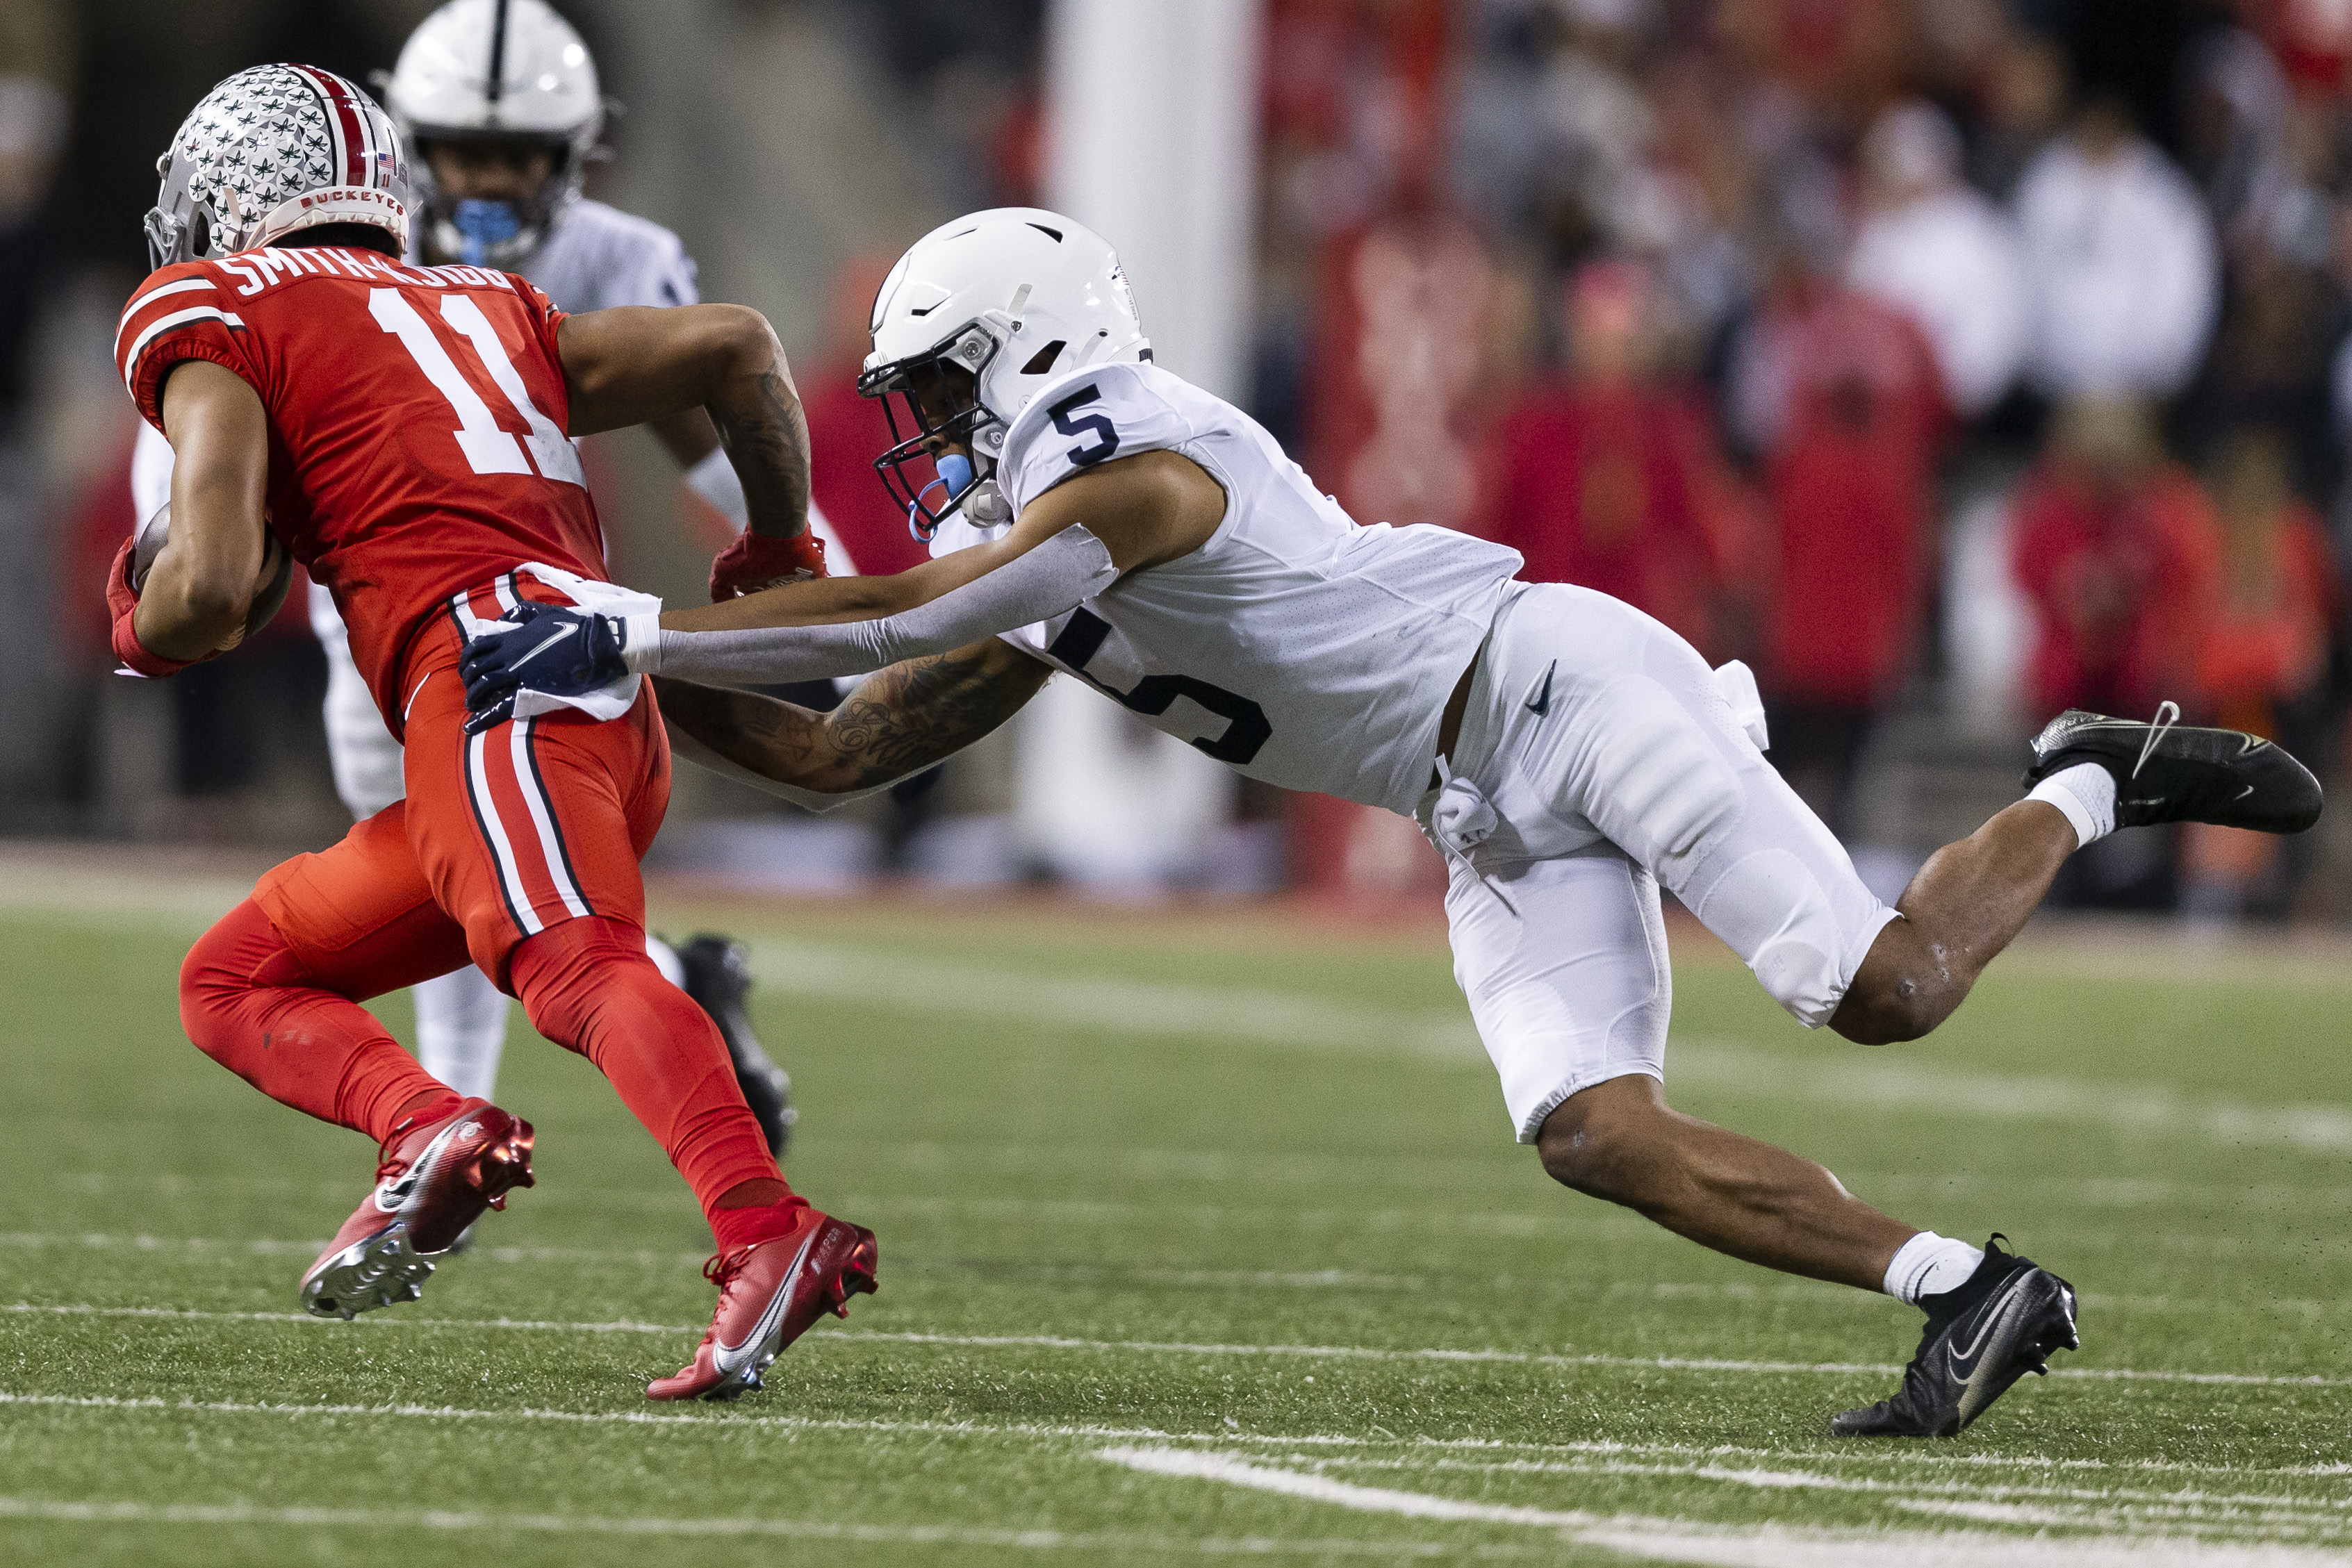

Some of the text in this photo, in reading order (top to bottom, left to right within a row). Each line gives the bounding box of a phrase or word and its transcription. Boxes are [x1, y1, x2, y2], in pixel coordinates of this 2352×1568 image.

[300, 190, 404, 215] BUCKEYES
[381, 173, 390, 188] 11
[368, 287, 588, 493] 11
[1046, 383, 1121, 466] 5
[1047, 605, 1273, 765] 5
